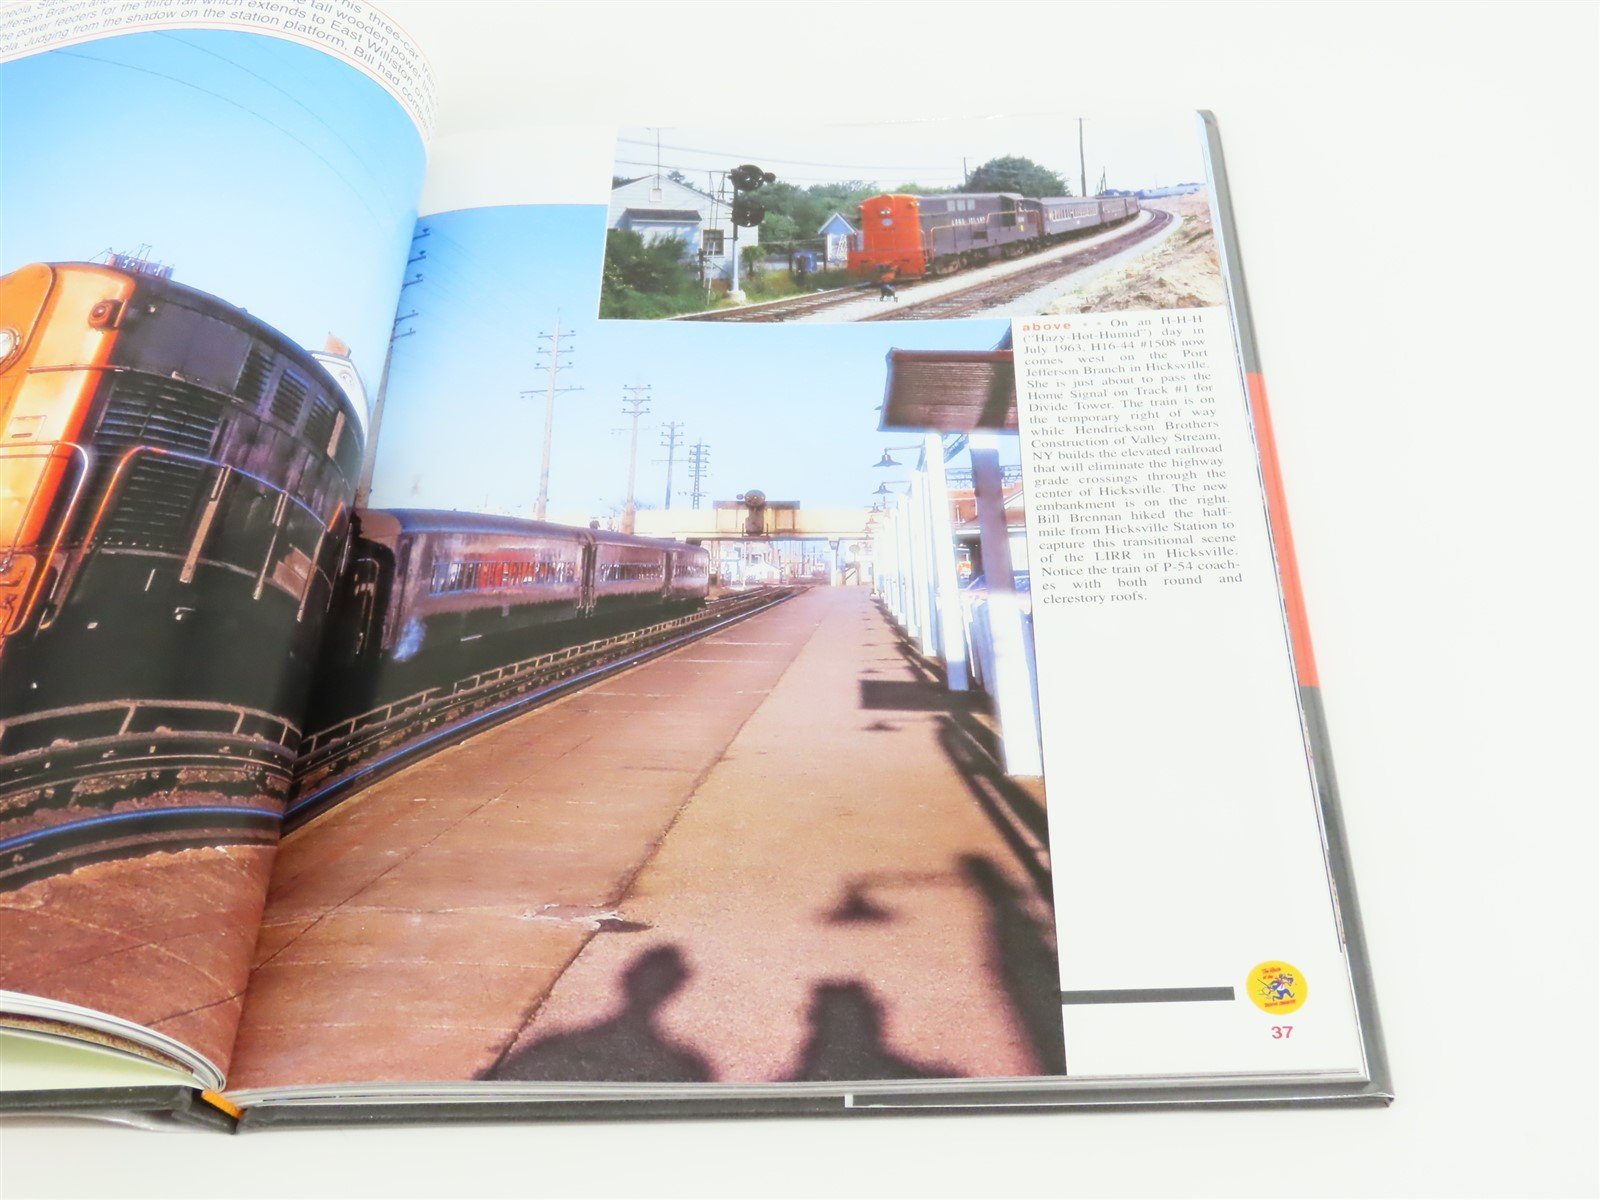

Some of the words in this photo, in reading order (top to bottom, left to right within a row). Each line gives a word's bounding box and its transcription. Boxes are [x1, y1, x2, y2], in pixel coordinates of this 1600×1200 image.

[16, 23, 51, 39] power
[56, 10, 97, 27] feeders
[101, 5, 119, 17] for
[247, 0, 306, 19] extends
[311, 12, 327, 25] to
[330, 19, 364, 43] East
[367, 38, 414, 86] Williston
[367, 11, 420, 60] three-car
[24, 28, 70, 47] Judging
[74, 22, 99, 35] from
[103, 17, 123, 27] the
[125, 10, 177, 24] shadow
[180, 10, 198, 19] on
[203, 8, 226, 19] the
[229, 10, 280, 26] station
[283, 19, 347, 51] platform.
[353, 44, 376, 65] Bill
[377, 62, 402, 86] had
[336, 9, 389, 46] wooden
[390, 45, 422, 80] power
[1022, 322, 1072, 331] above
[1110, 319, 1128, 327] On
[1161, 315, 1202, 324] H-H-H
[1023, 330, 1152, 343] ("Hazy-Hot-Humid")
[1161, 328, 1182, 336] day
[1024, 346, 1047, 355] July
[1055, 344, 1085, 353] 1963,
[1091, 341, 1134, 351] H16-44
[1140, 339, 1176, 348] #1508
[1024, 357, 1063, 365] comes
[1078, 355, 1105, 363] west
[1149, 351, 1167, 359] the
[1183, 349, 1208, 358] Port
[1025, 367, 1079, 377] Jefferson
[1084, 365, 1124, 374] Branch
[1146, 361, 1209, 371] Hicksville.
[1027, 380, 1048, 388] She
[1056, 379, 1065, 387] is
[1073, 378, 1094, 388] just
[1101, 377, 1134, 385] about
[1161, 375, 1186, 384] pass
[1193, 372, 1211, 380] the
[1028, 392, 1063, 400] Home
[1070, 389, 1107, 400] Signal
[1135, 386, 1167, 395] Track
[1174, 385, 1188, 393] #1
[1196, 384, 1214, 392] for
[1029, 403, 1068, 412] Divide
[1074, 401, 1114, 410] Tower.
[1120, 399, 1144, 408] The
[1150, 398, 1177, 406] train
[1029, 416, 1048, 424] the
[1058, 412, 1120, 424] temporary
[1130, 411, 1159, 421] right
[1169, 409, 1182, 417] of
[1192, 409, 1216, 417] way
[1031, 427, 1064, 435] while
[1075, 423, 1154, 434] Hendrickson
[1165, 420, 1219, 430] Brothers
[1031, 438, 1108, 448] Construction
[1114, 437, 1128, 445] of
[1131, 434, 1168, 444] Valley
[1174, 433, 1221, 442] Stream,
[1032, 452, 1053, 460] NY
[1058, 449, 1094, 459] builds
[1099, 449, 1117, 457] the
[1121, 446, 1171, 456] elevated
[1175, 444, 1222, 453] railroad
[1033, 465, 1055, 473] that
[1061, 463, 1083, 472] will
[1088, 461, 1144, 471] eliminate
[1149, 459, 1167, 468] the
[1172, 457, 1224, 468] highway
[1034, 477, 1069, 487] grade
[1079, 473, 1138, 484] crossings
[1148, 471, 1197, 481] through
[1207, 469, 1226, 477] the
[1035, 489, 1072, 498] center
[1079, 487, 1091, 496] of
[1099, 485, 1166, 495] Hicksville.
[1172, 483, 1196, 492] The
[1203, 483, 1227, 491] new
[1036, 501, 1115, 511] embankment
[1169, 496, 1187, 505] the
[1197, 495, 1230, 505] right.
[1038, 515, 1060, 523] Bill
[1070, 513, 1122, 521] Brennan
[1131, 511, 1165, 520] hiked
[1174, 509, 1193, 518] the
[1203, 507, 1232, 516] half-
[1039, 528, 1065, 536] mile
[1071, 526, 1100, 535] from
[1105, 523, 1168, 533] Hicksville
[1173, 521, 1217, 531] Station
[1039, 541, 1085, 551] capture
[1093, 539, 1115, 548] this
[1123, 536, 1194, 546] transitional
[1201, 534, 1236, 543] scene
[1040, 554, 1053, 563] of
[1064, 553, 1084, 562] the
[1095, 551, 1130, 560] LIRR
[1143, 550, 1155, 559] in
[1167, 546, 1239, 558] Hicksville.
[1042, 567, 1083, 576] Notice
[1088, 566, 1107, 574] the
[1112, 564, 1140, 573] train
[1146, 563, 1158, 571] of
[1164, 561, 1193, 571] P-54
[1198, 560, 1240, 570] coach-
[1042, 582, 1056, 590] es
[1073, 580, 1101, 589] with
[1118, 578, 1146, 587] both
[1164, 575, 1202, 585] round
[1219, 573, 1242, 582] and
[1043, 593, 1105, 604] clerestory
[1111, 591, 1147, 602] roofs.
[1271, 1026, 1293, 1039] 37
